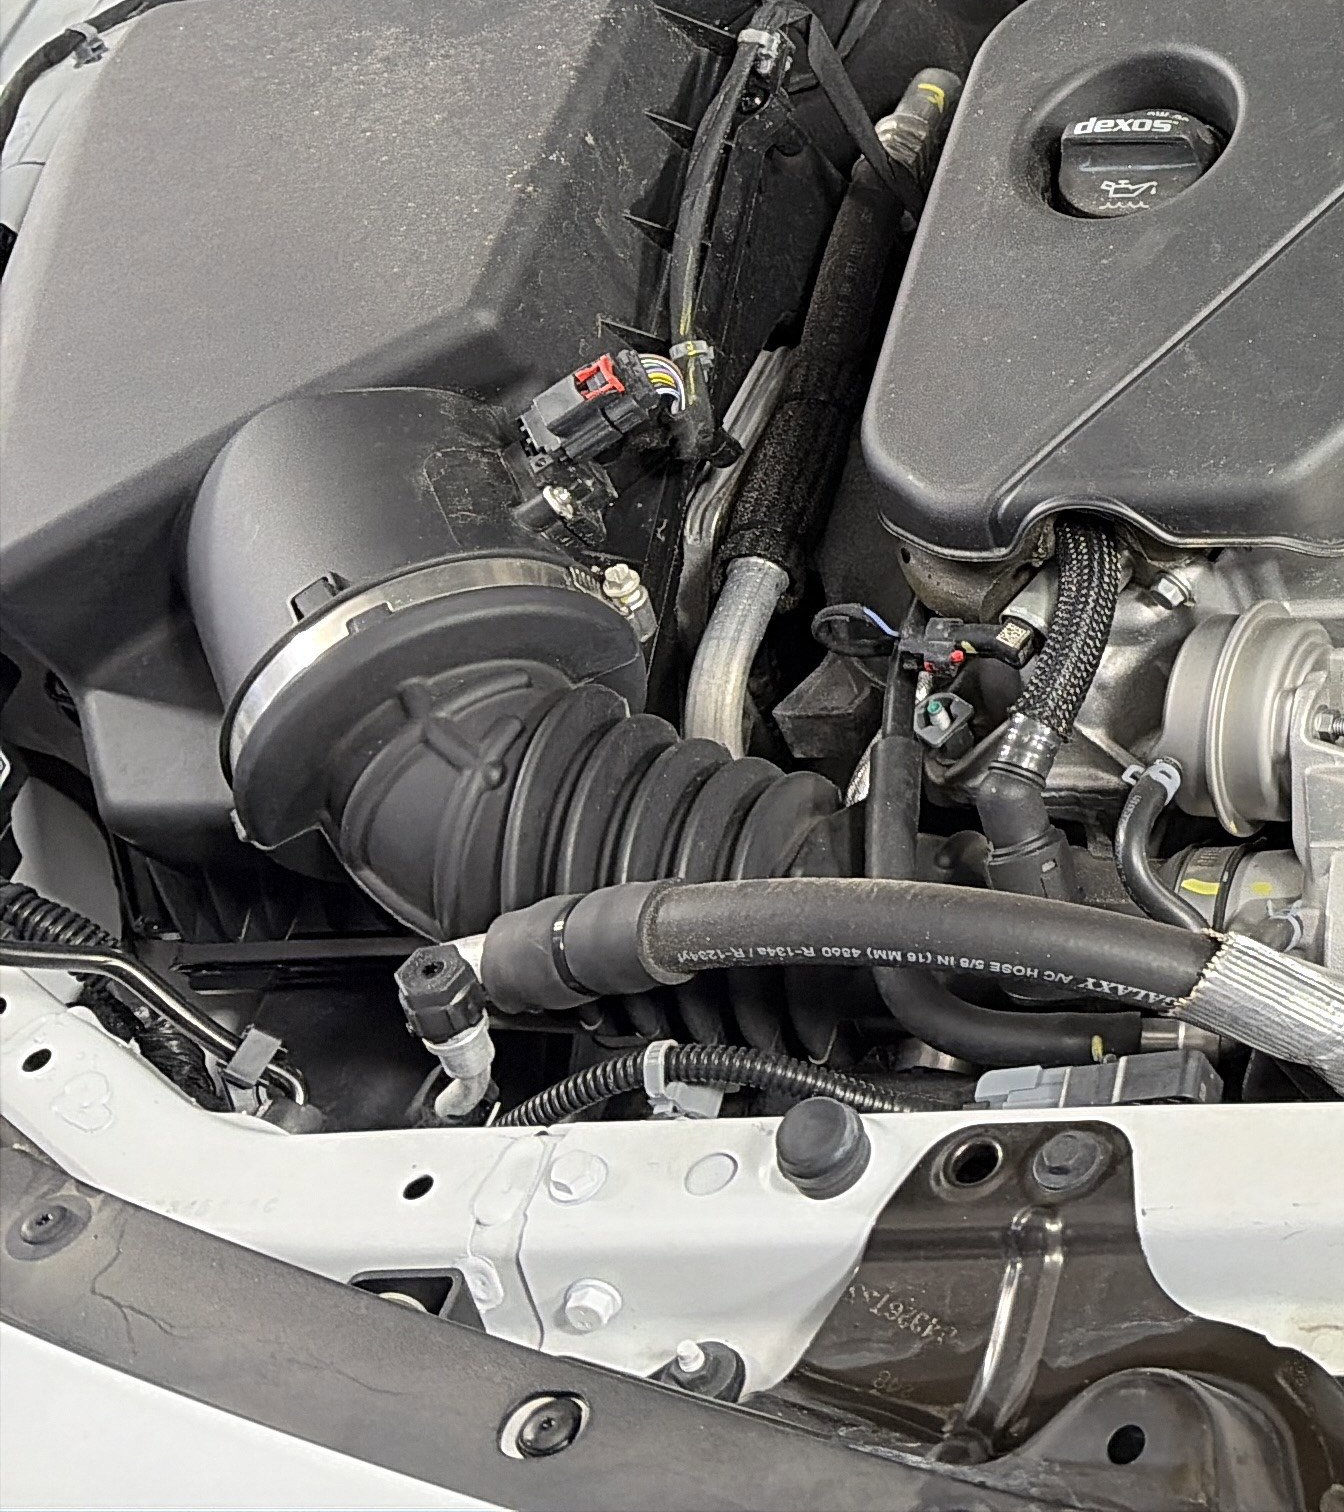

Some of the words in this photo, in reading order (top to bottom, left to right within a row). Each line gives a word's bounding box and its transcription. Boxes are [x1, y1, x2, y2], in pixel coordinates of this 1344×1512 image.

[1073, 116, 1174, 136] dexos
[756, 946, 817, 959] R-134a
[866, 946, 902, 962] MM)
[936, 954, 955, 967] IN
[959, 956, 985, 970] 5/8
[988, 960, 1039, 979] HOSE
[1042, 970, 1074, 984] A/C
[1075, 977, 1181, 1007] GALAXY
